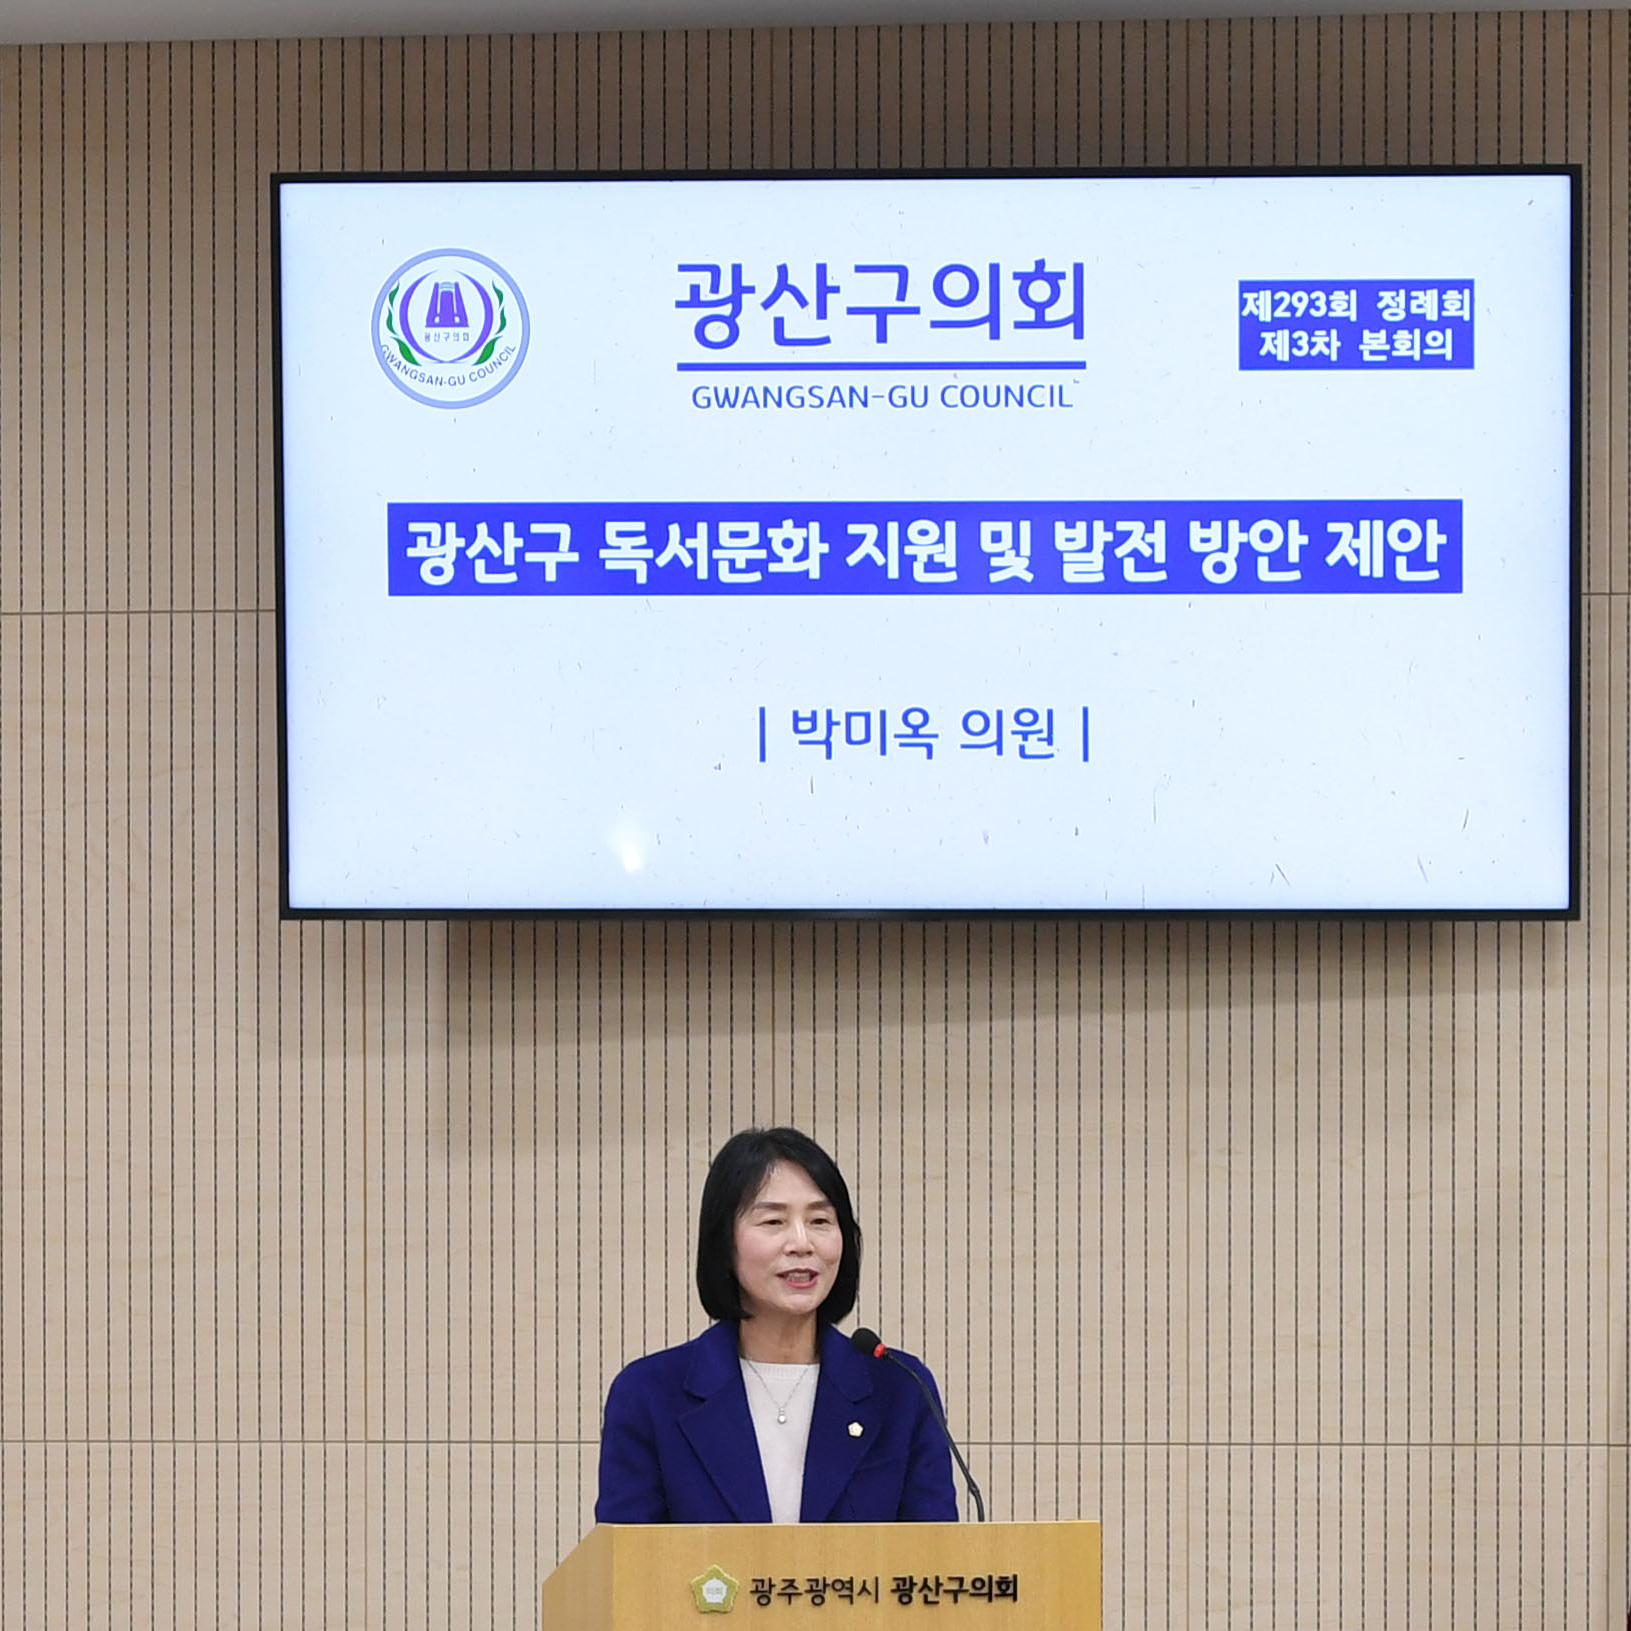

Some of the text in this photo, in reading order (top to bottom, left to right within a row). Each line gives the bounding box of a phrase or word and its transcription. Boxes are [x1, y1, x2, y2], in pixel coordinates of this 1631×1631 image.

[674, 257, 1085, 350] 광산구의회
[1241, 288, 1471, 322] 제293회 정례회
[1259, 328, 1453, 362] 제3차 본회의
[469, 345, 516, 382] COUNCIL
[692, 384, 1074, 410] GWANGSAN-GU COUNCIL
[406, 518, 1448, 586] 광산구 독서문화 지원 및 발전 방안 제안
[792, 706, 1055, 761] 박미옥 의원
[749, 1574, 1019, 1607] 광주광역시 광산구의회
